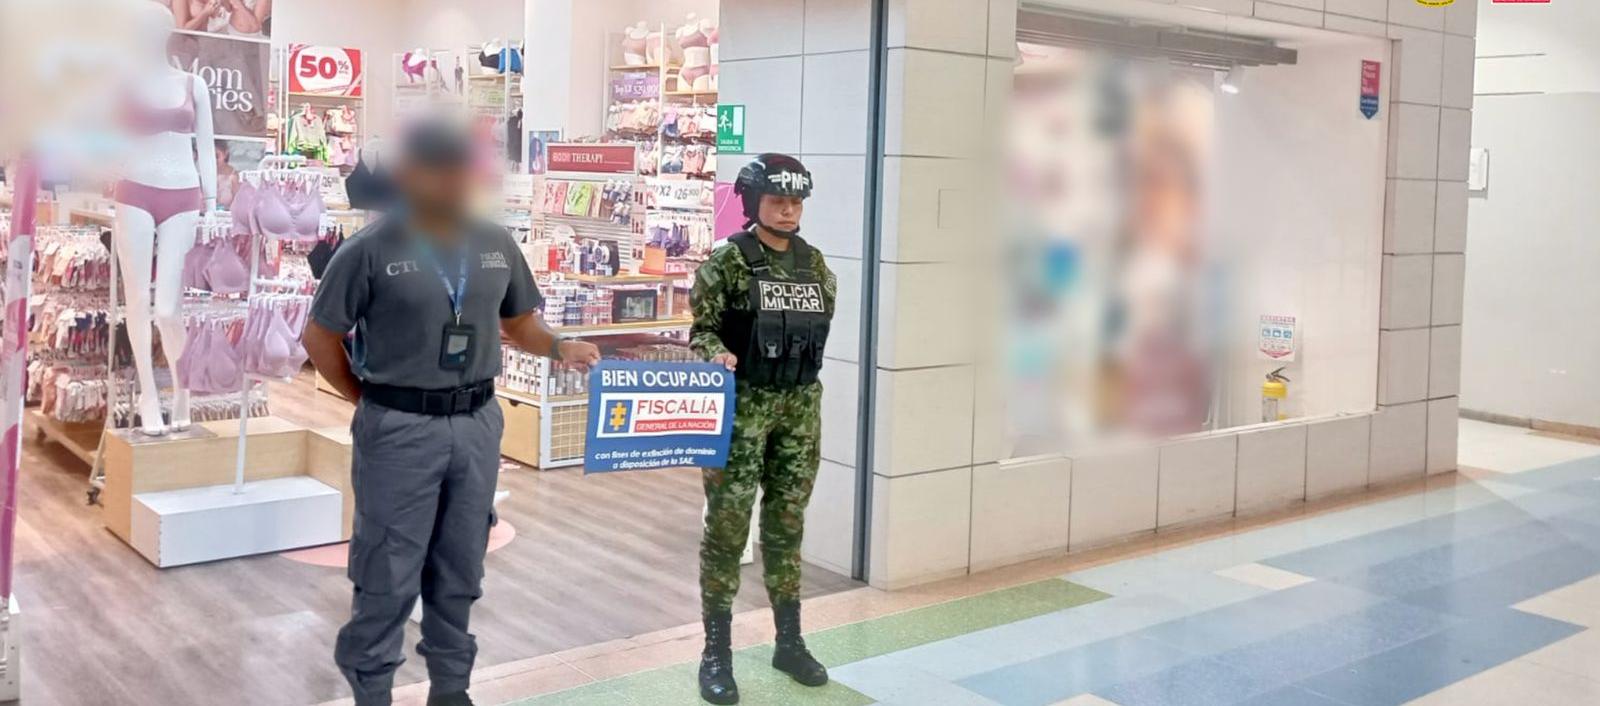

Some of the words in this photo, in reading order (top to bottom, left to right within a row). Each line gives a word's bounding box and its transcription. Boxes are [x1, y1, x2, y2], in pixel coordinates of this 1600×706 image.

[572, 152, 603, 163] THERAPY
[781, 170, 804, 190] PM
[763, 284, 818, 298] POLICIA
[764, 296, 820, 310] MILITAR
[602, 370, 638, 387] BIEN
[642, 371, 724, 387] OCUPADO
[637, 396, 718, 414] FISCALÍA
[636, 421, 667, 430] GENERAL
[678, 421, 687, 429] LA
[688, 420, 715, 429] NACIÓN
[595, 452, 610, 460] con
[611, 450, 629, 460] fines
[630, 449, 640, 458] de
[642, 448, 673, 458] extinción
[674, 447, 684, 456] de
[685, 447, 716, 456] dominio
[619, 459, 660, 470] disposición
[661, 458, 670, 467] de
